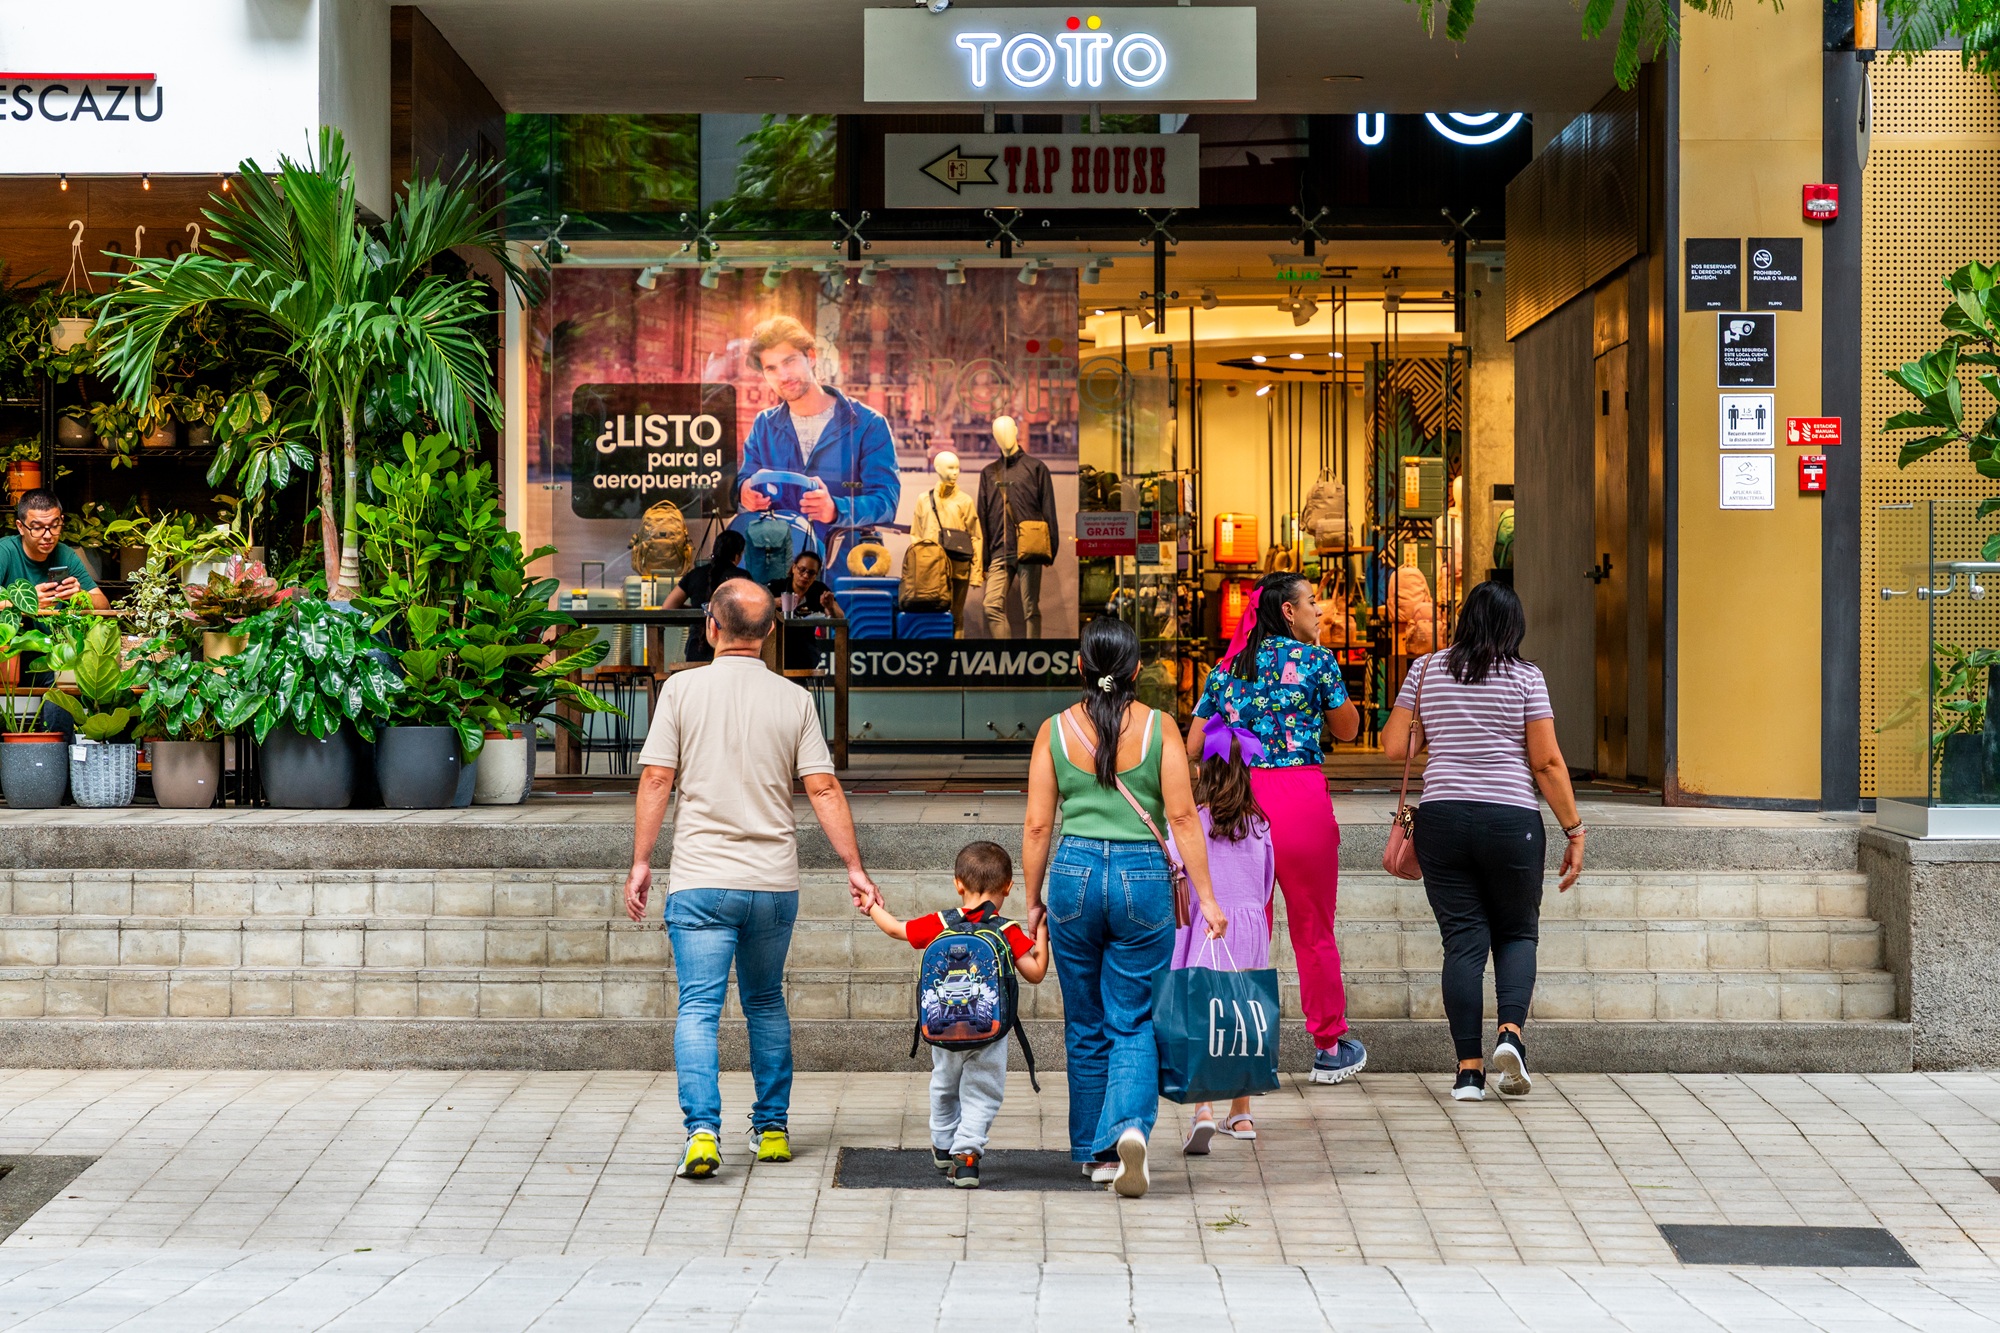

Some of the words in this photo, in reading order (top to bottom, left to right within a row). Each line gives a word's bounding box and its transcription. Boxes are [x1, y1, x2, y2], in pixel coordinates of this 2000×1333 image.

[955, 32, 1167, 88] TOTTO
[1004, 147, 1060, 194] TAP
[1071, 147, 1166, 194] HOUSE
[595, 414, 722, 454] ¿LISTO
[648, 452, 698, 472] para
[702, 449, 722, 467] el
[593, 471, 722, 494] aeropuerto?
[1086, 527, 1125, 536] GRATIS
[815, 651, 939, 676] ¿LSTOS?
[948, 650, 1080, 676] ¡VAMOS!
[1209, 997, 1268, 1058] GAP
